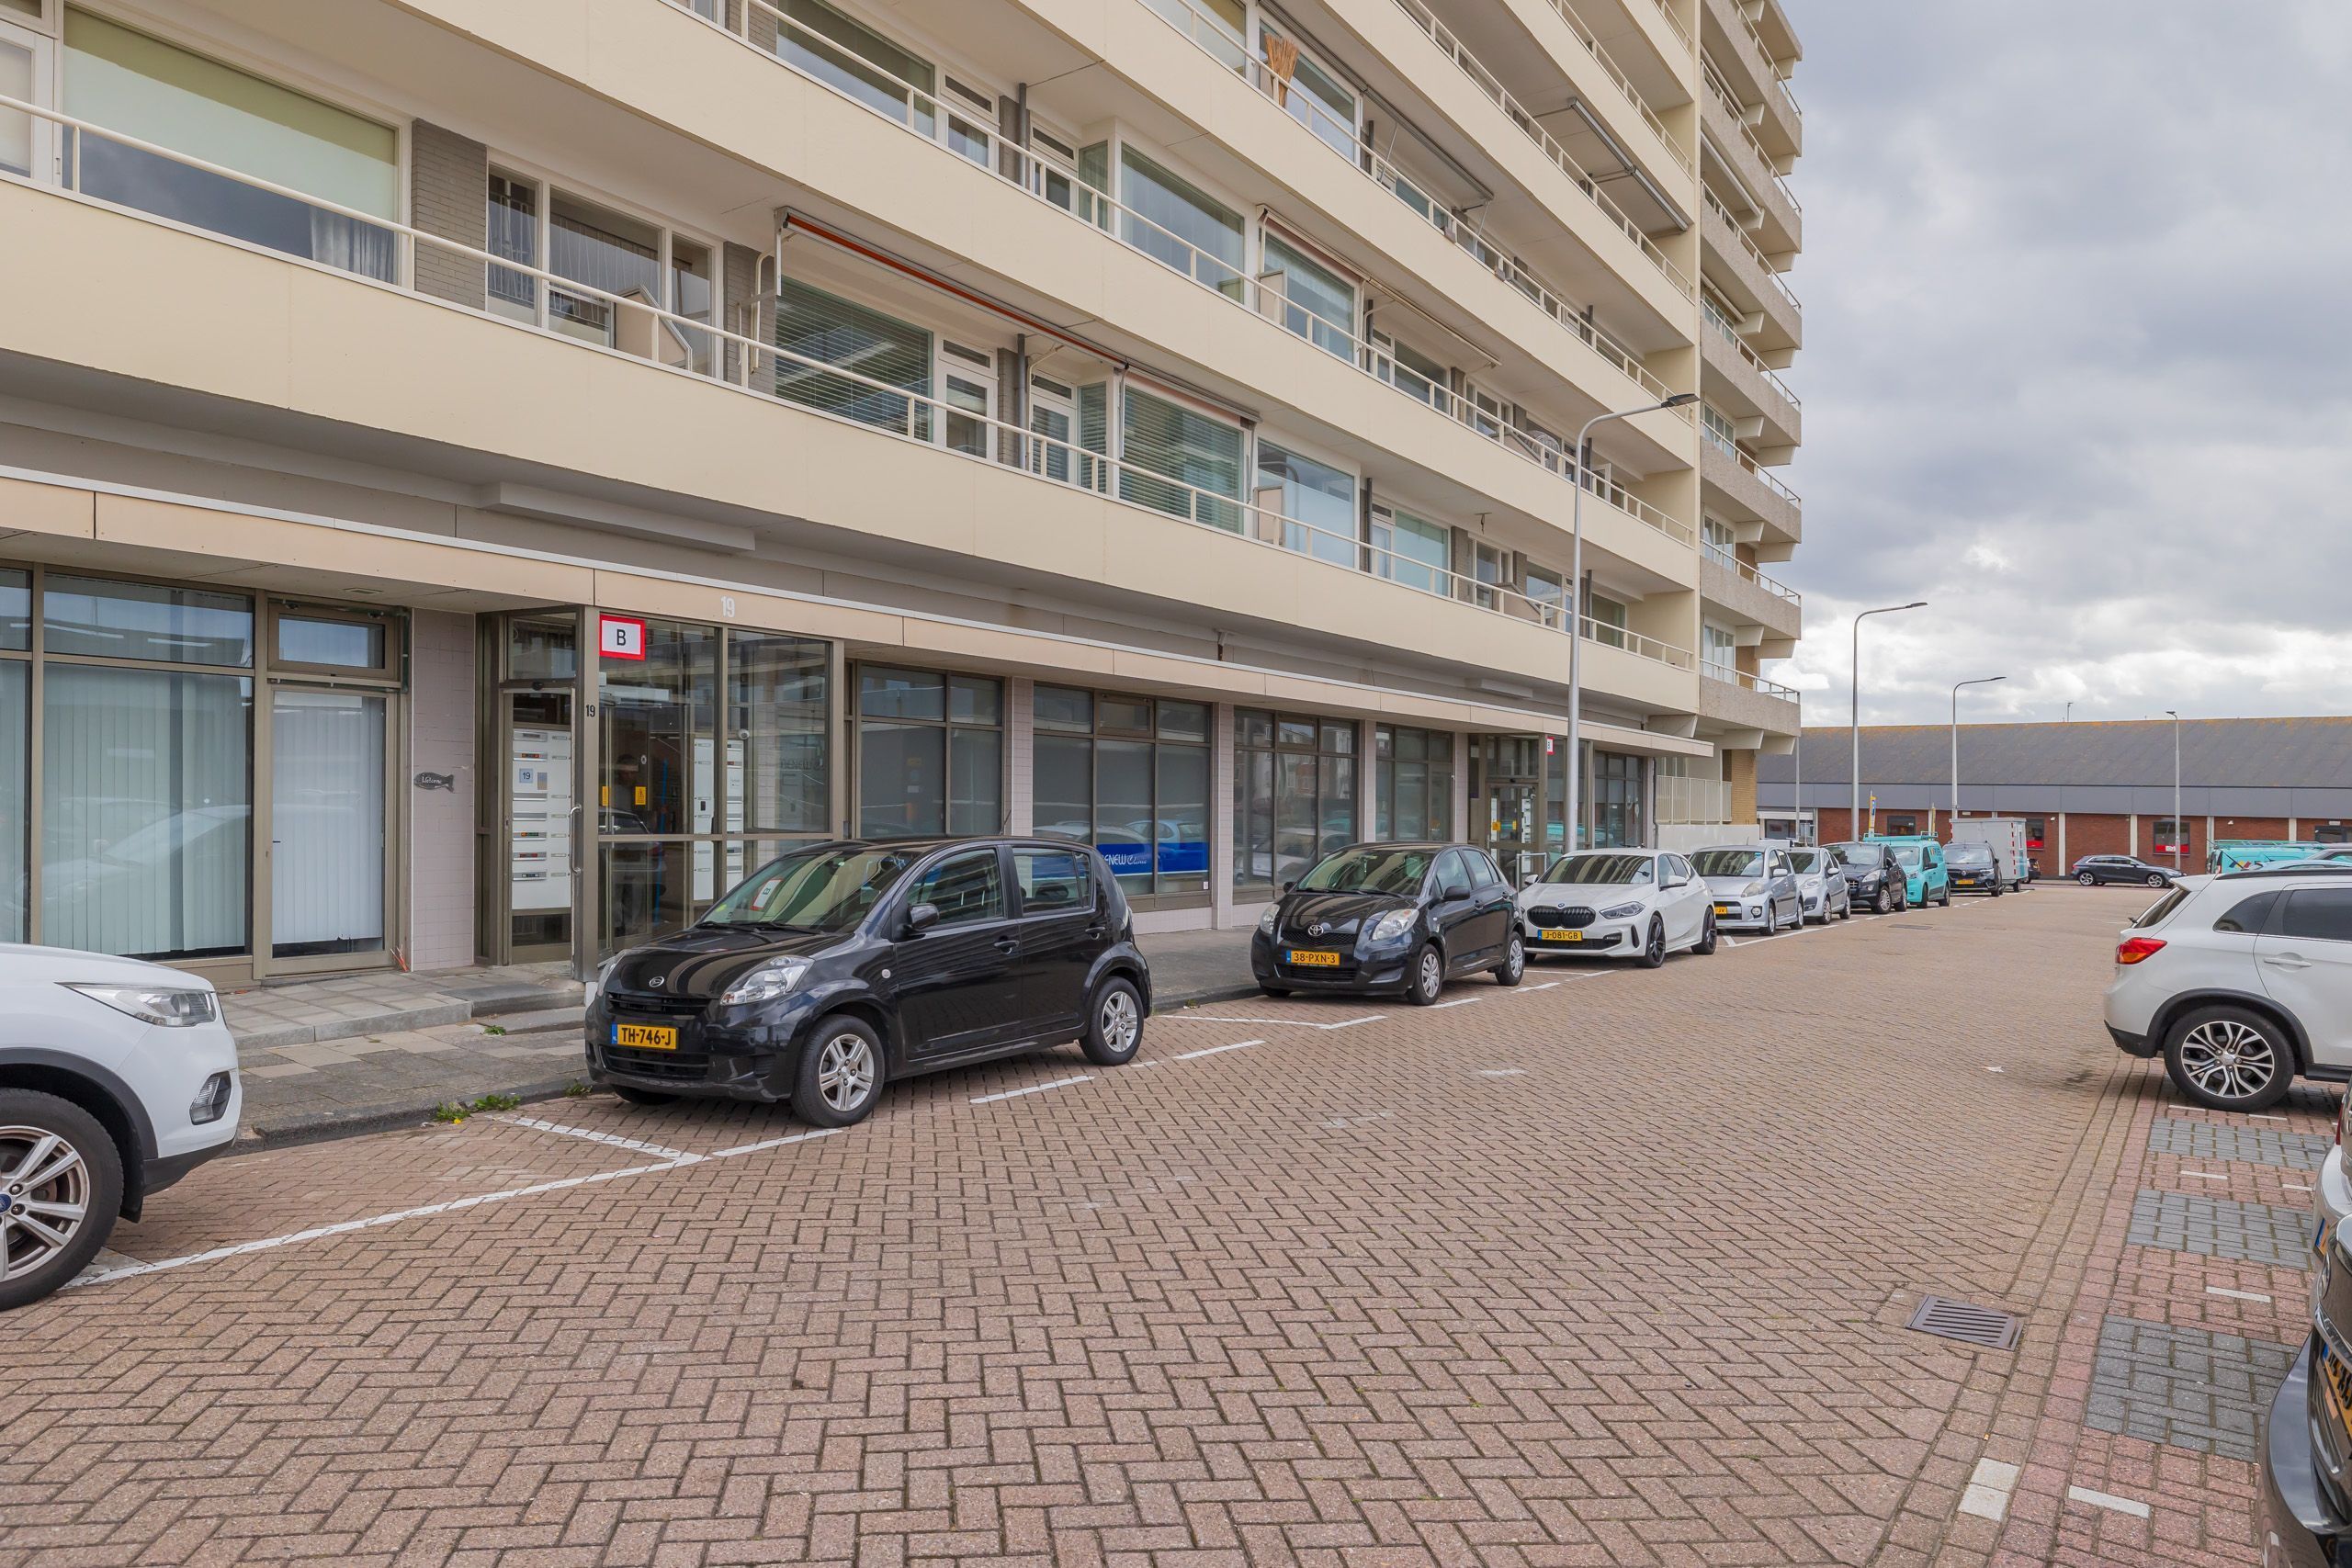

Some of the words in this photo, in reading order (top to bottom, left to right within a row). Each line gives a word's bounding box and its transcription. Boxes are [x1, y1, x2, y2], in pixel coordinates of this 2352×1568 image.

[720, 595, 736, 618] 19
[616, 628, 627, 647] B
[585, 704, 596, 717] 19
[522, 772, 531, 780] 19
[1545, 931, 1578, 940] J-081-GB
[1294, 953, 1336, 964] 38-PXN-3
[621, 1027, 672, 1046] TH-746-J
